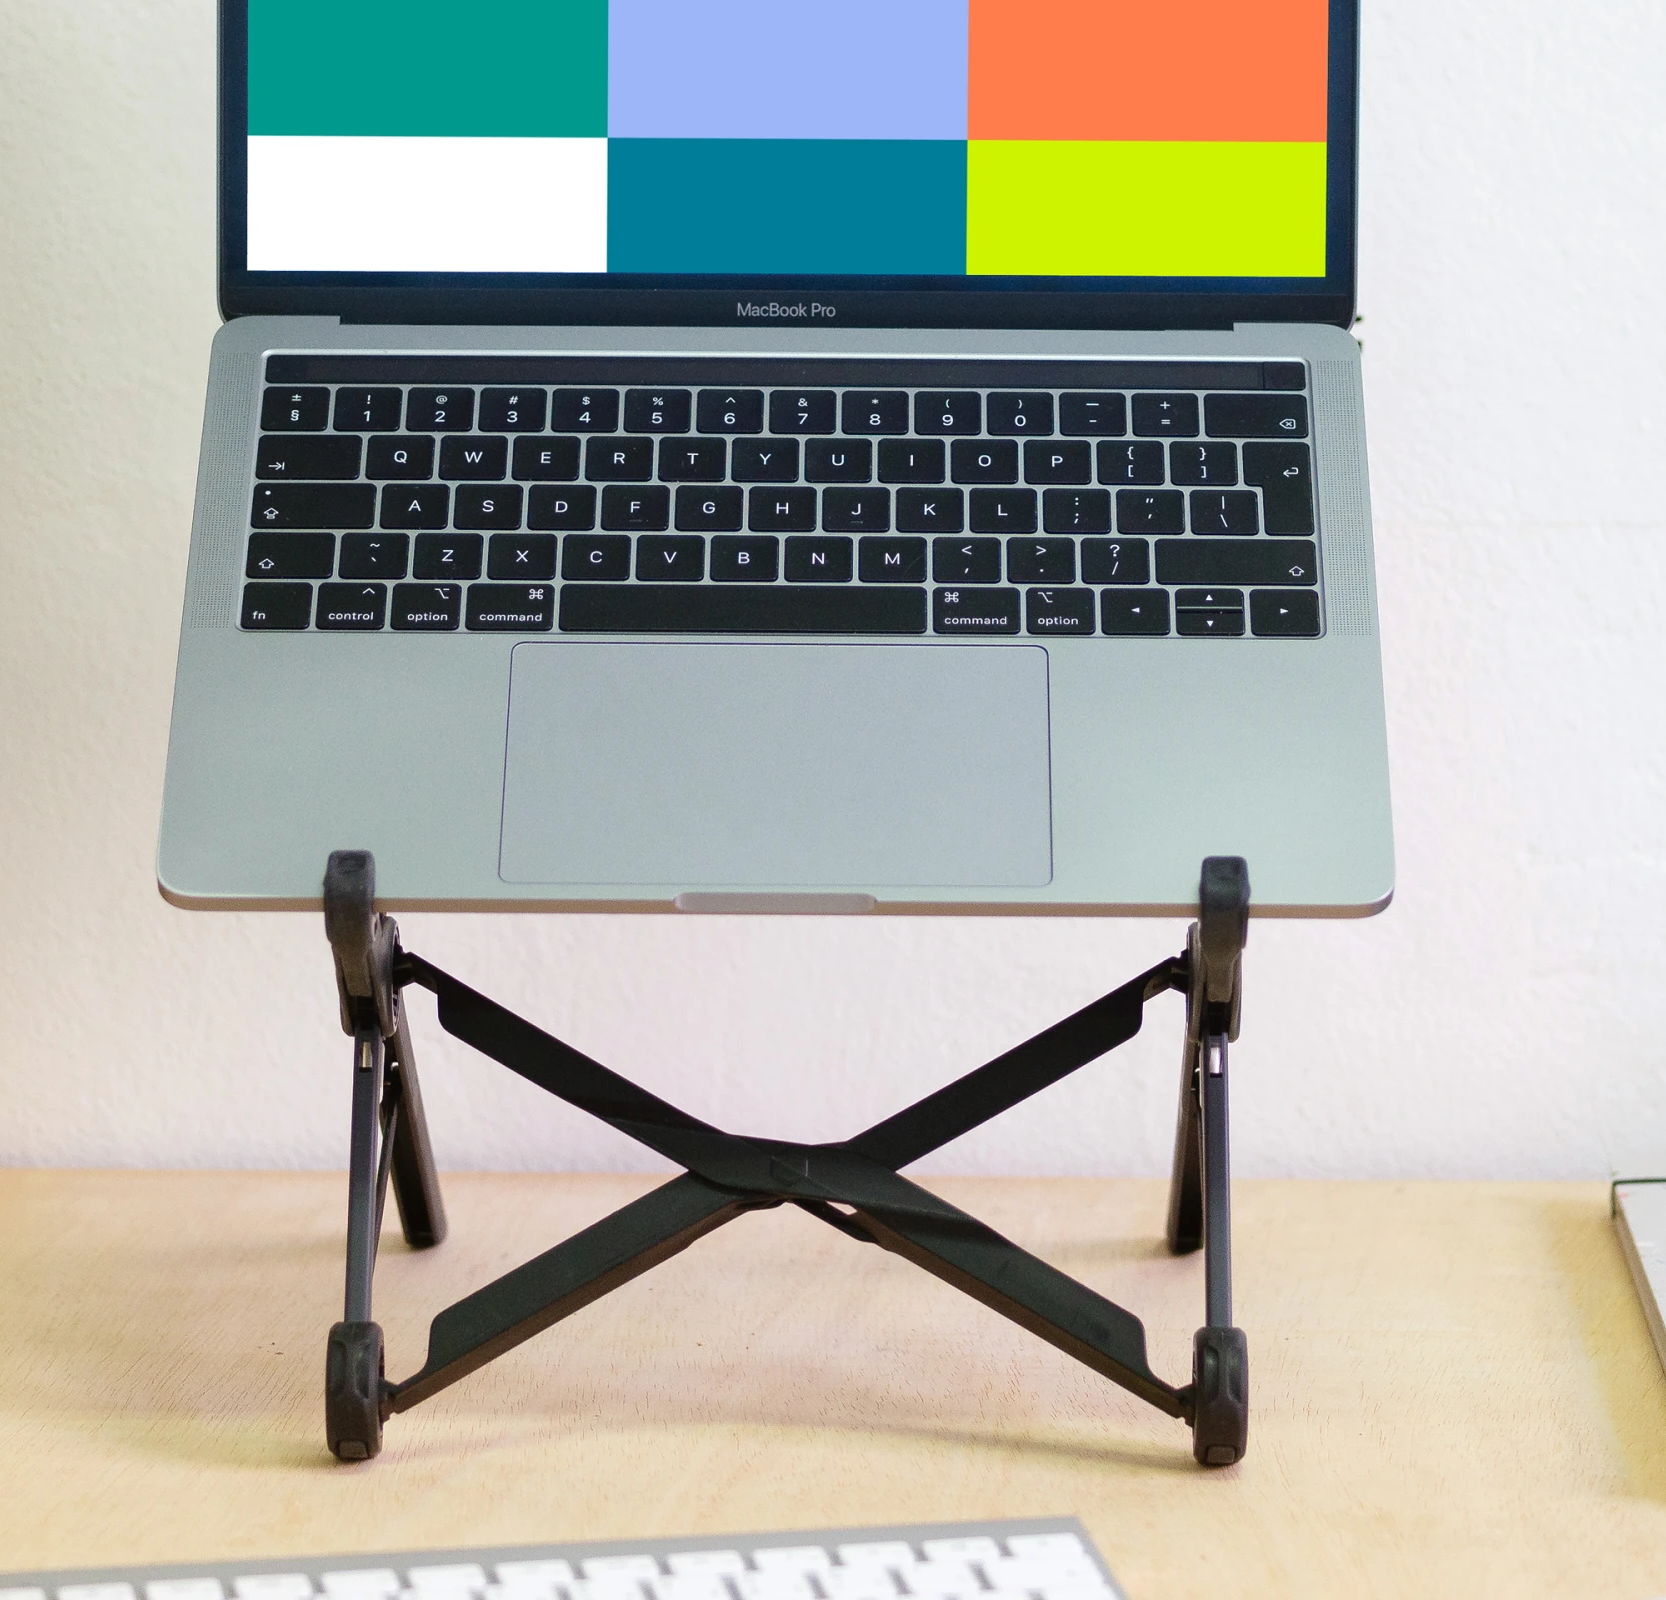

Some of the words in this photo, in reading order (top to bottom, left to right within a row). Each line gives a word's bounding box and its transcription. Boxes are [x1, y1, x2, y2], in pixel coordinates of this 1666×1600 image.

[736, 302, 808, 318] MacBook
[810, 302, 837, 318] Pro
[435, 394, 448, 405] @
[508, 395, 519, 405] #
[581, 396, 591, 406] $
[652, 396, 664, 406] %
[797, 397, 808, 407] &
[1159, 401, 1171, 410] +
[434, 410, 446, 423] 2
[506, 410, 518, 423] 3
[578, 411, 591, 424] 4
[651, 411, 663, 424] 5
[723, 412, 736, 425] 6
[797, 412, 809, 425] 7
[869, 413, 881, 426] 8
[941, 414, 954, 427] 9
[1014, 414, 1027, 427] 0
[393, 450, 408, 464] Q
[464, 451, 483, 464] W
[540, 451, 552, 464] E
[613, 452, 626, 465] R
[686, 452, 699, 465] T
[759, 453, 772, 466] Y
[831, 453, 845, 466] U
[978, 454, 992, 467] O
[1051, 455, 1064, 468] P
[1126, 446, 1135, 460] {
[408, 499, 422, 512] A
[482, 499, 494, 513] S
[555, 500, 568, 513] D
[630, 501, 641, 514] F
[702, 501, 716, 514] G
[775, 502, 789, 515] H
[851, 502, 862, 516] J
[923, 503, 936, 516] K
[997, 503, 1009, 516] L
[1219, 514, 1228, 528] \
[441, 549, 454, 562] Z
[515, 549, 529, 563] X
[589, 550, 603, 564] C
[663, 551, 677, 564] V
[737, 551, 751, 565] B
[811, 552, 825, 565] N
[884, 552, 901, 565] M
[961, 545, 973, 555] <
[1035, 545, 1047, 556] >
[1109, 544, 1121, 558] ?
[252, 610, 266, 620] fn
[327, 610, 375, 621] control
[407, 611, 448, 623] option
[479, 611, 543, 622] command
[944, 614, 1008, 626] command
[1037, 615, 1079, 627] option
